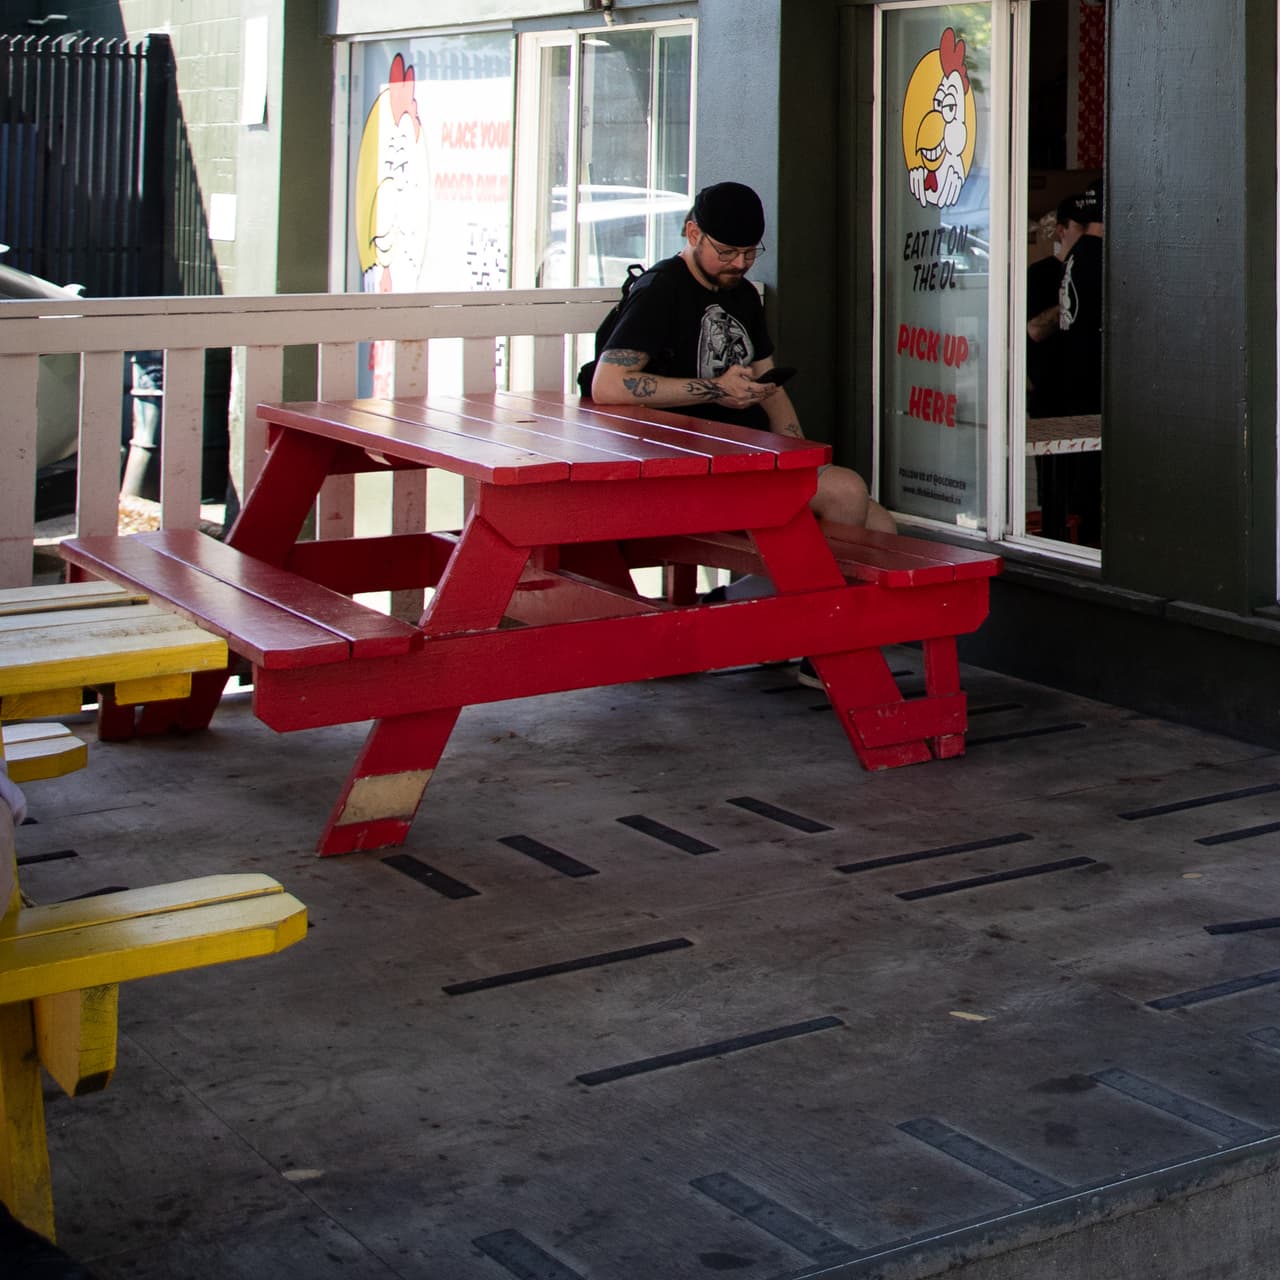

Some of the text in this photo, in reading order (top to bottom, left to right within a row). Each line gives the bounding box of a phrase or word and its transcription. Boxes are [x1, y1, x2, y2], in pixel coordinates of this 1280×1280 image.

[441, 120, 478, 150] PLACE
[903, 224, 968, 261] EAT IT ON
[913, 260, 956, 292] THE DL
[897, 323, 969, 368] PICK UP
[908, 385, 957, 428] HERE
